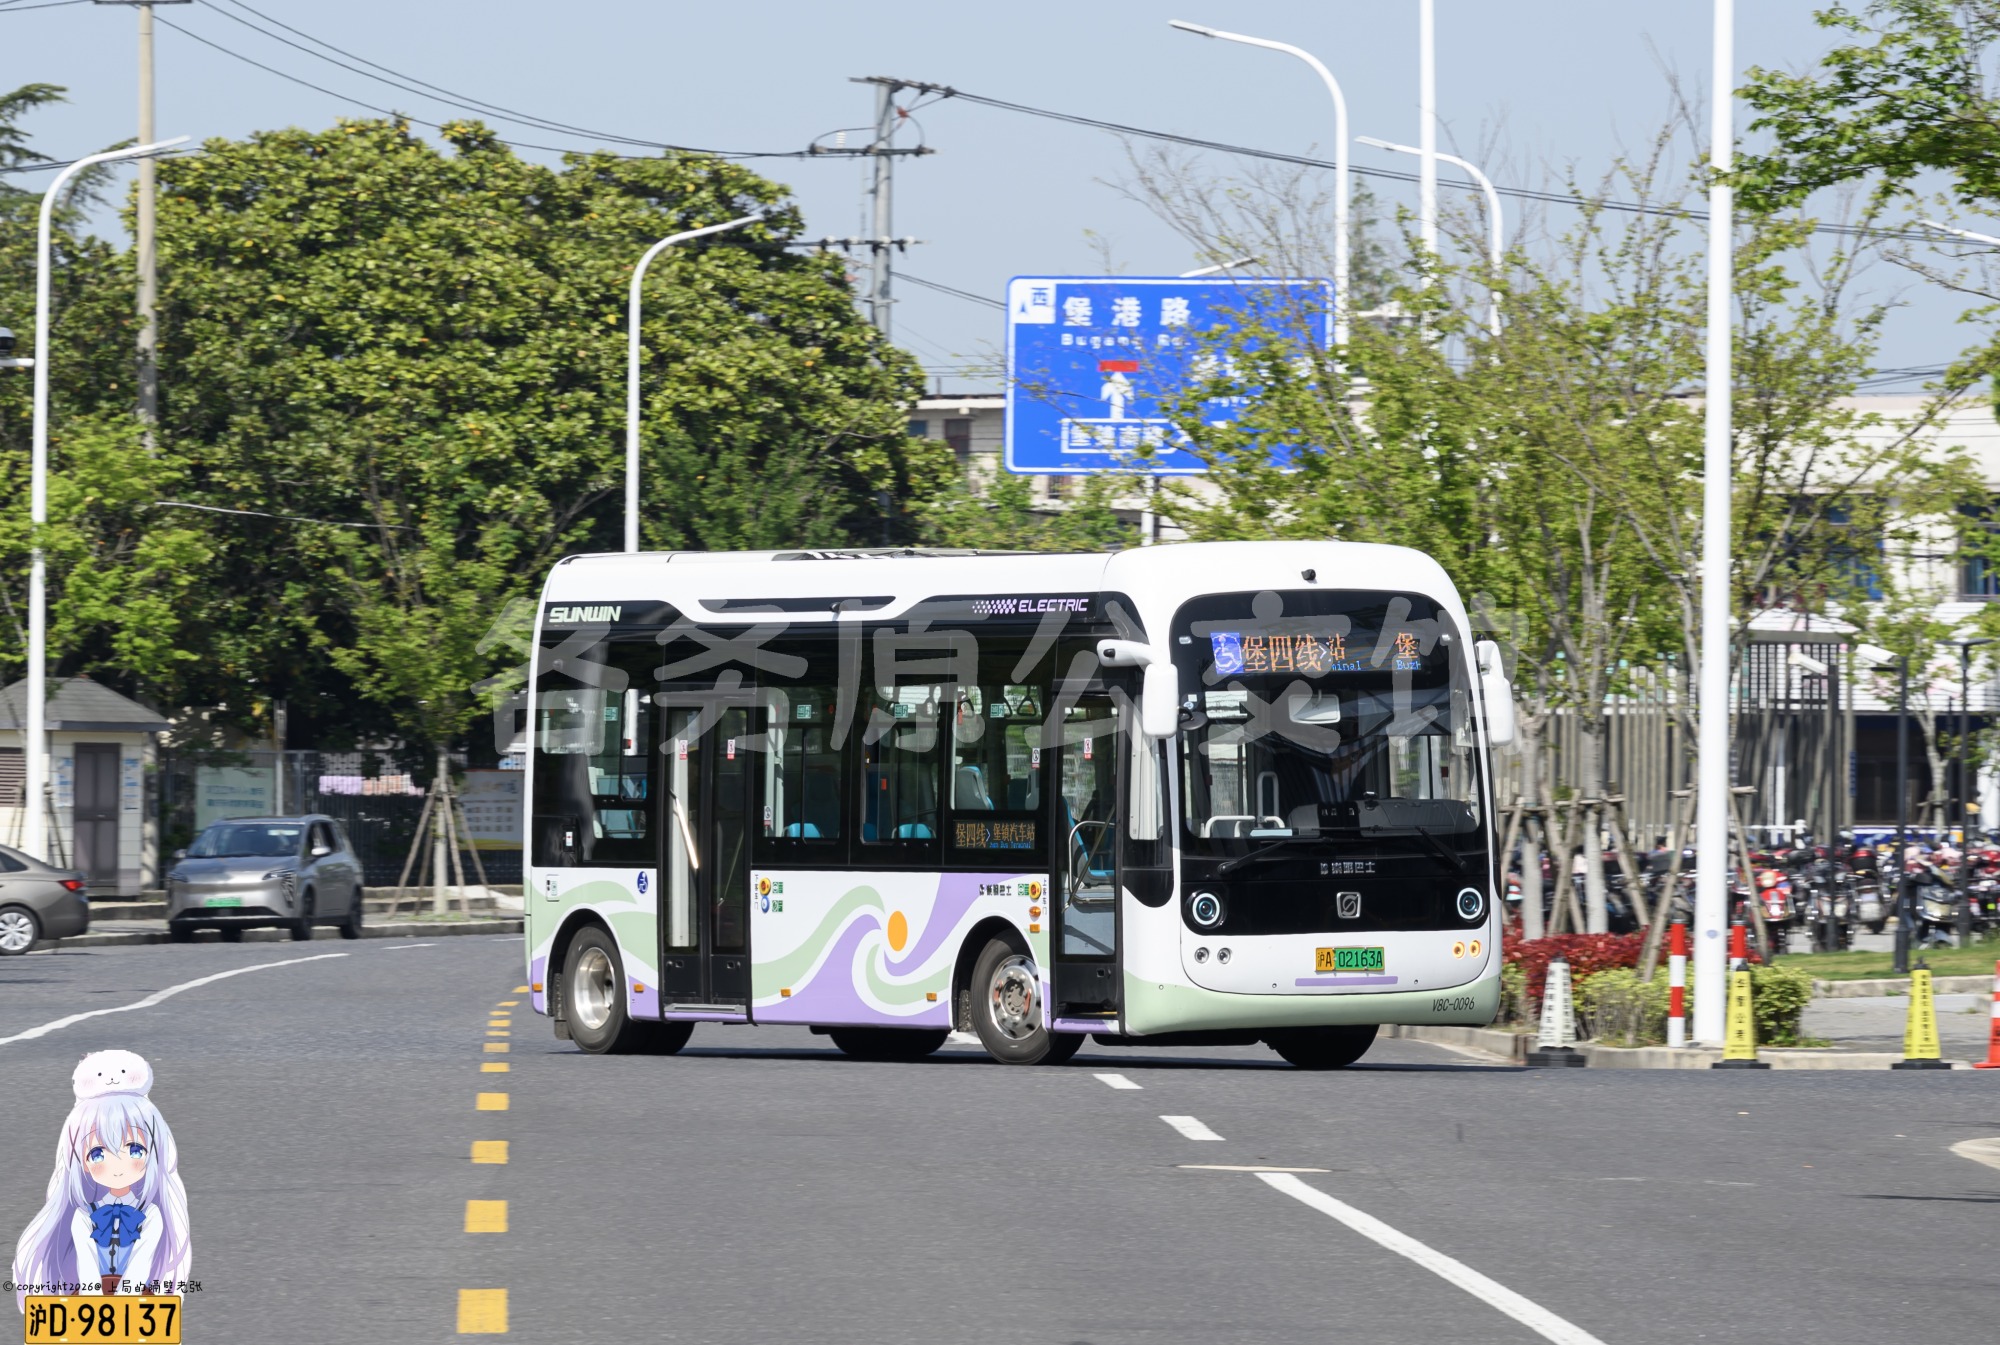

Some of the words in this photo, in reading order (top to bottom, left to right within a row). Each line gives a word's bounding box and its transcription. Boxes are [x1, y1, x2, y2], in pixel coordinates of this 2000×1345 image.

[1030, 287, 1049, 305] 西
[1063, 297, 1191, 326] 堡港路
[549, 605, 621, 623] SUNWIN
[1018, 599, 1089, 613] ELECTRIC
[1243, 634, 1321, 672] 堡四线
[1395, 633, 1419, 659] 堡
[956, 823, 986, 848] 堡四线
[993, 823, 1036, 842] 堡镇汽车站
